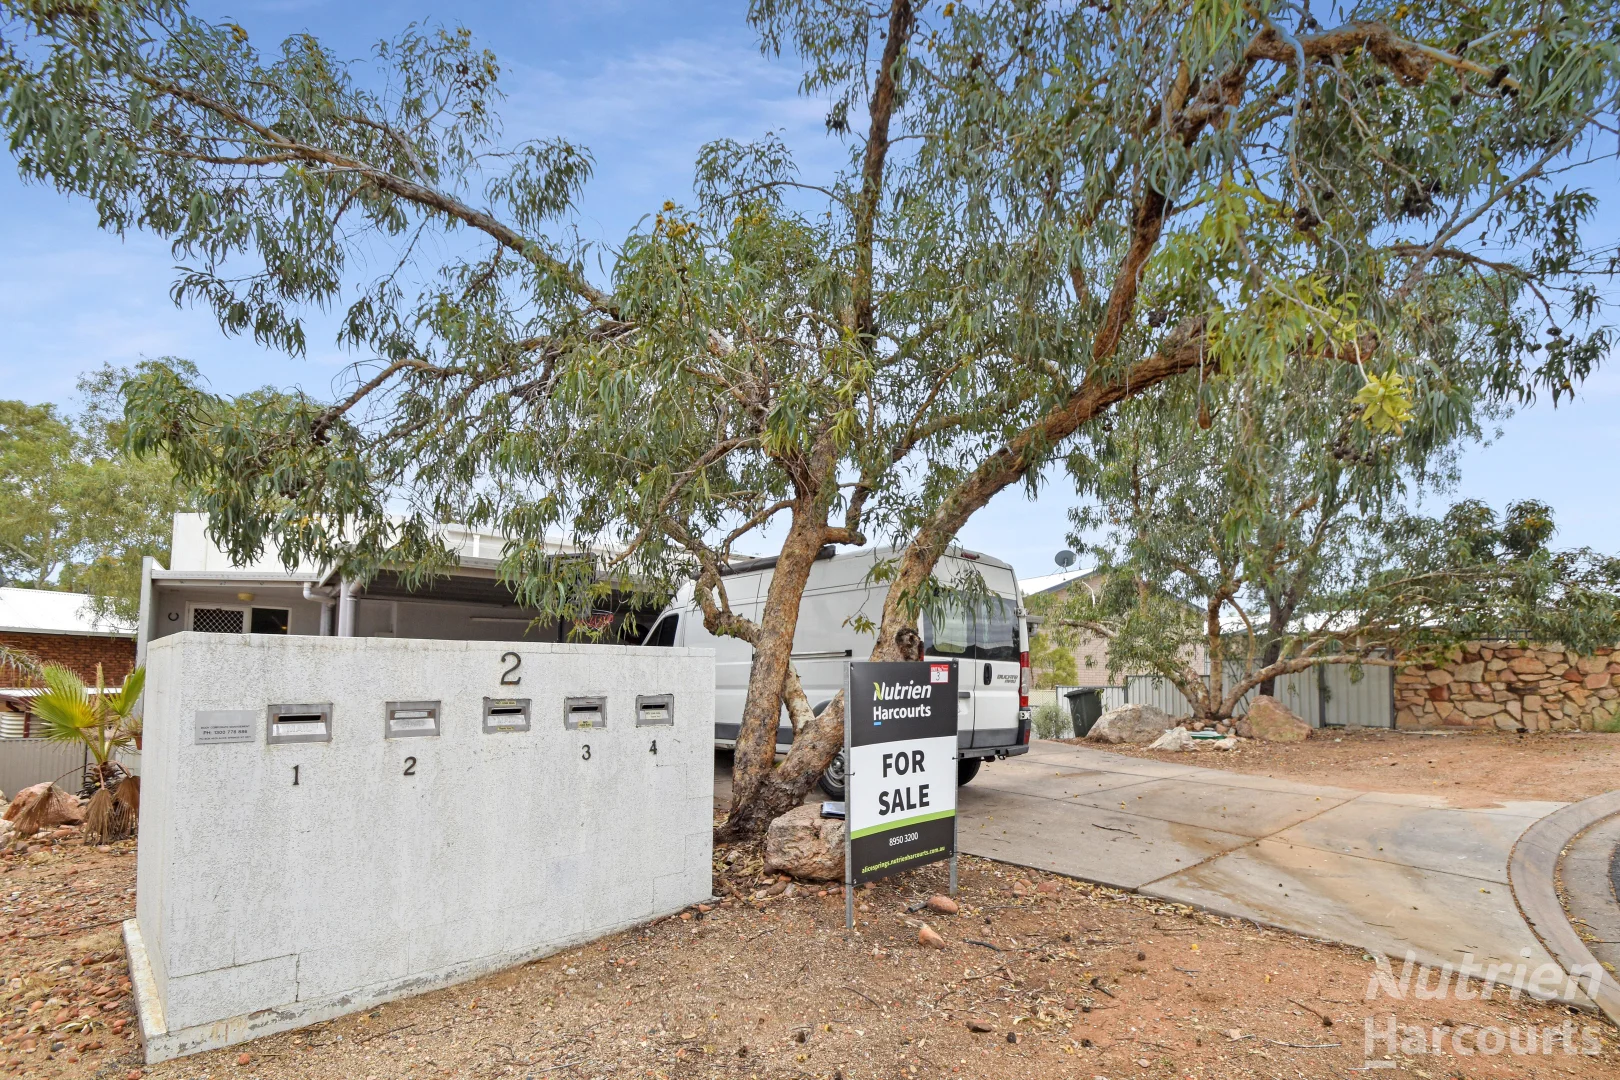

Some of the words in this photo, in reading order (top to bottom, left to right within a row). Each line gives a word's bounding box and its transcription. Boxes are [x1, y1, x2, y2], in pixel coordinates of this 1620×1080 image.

[500, 652, 522, 685] 2
[935, 671, 941, 681] 3
[873, 680, 932, 701] Nutrien
[873, 704, 932, 721] Harcourts
[581, 744, 592, 761] 3
[649, 739, 658, 755] 4
[403, 756, 417, 776] 2
[882, 750, 926, 778] FOR
[292, 764, 300, 786] 1
[878, 783, 930, 816] SALE
[889, 835, 904, 847] 8950
[904, 831, 919, 843] 3200
[861, 846, 946, 874] alicesprings.nutrienharcourts.com.au
